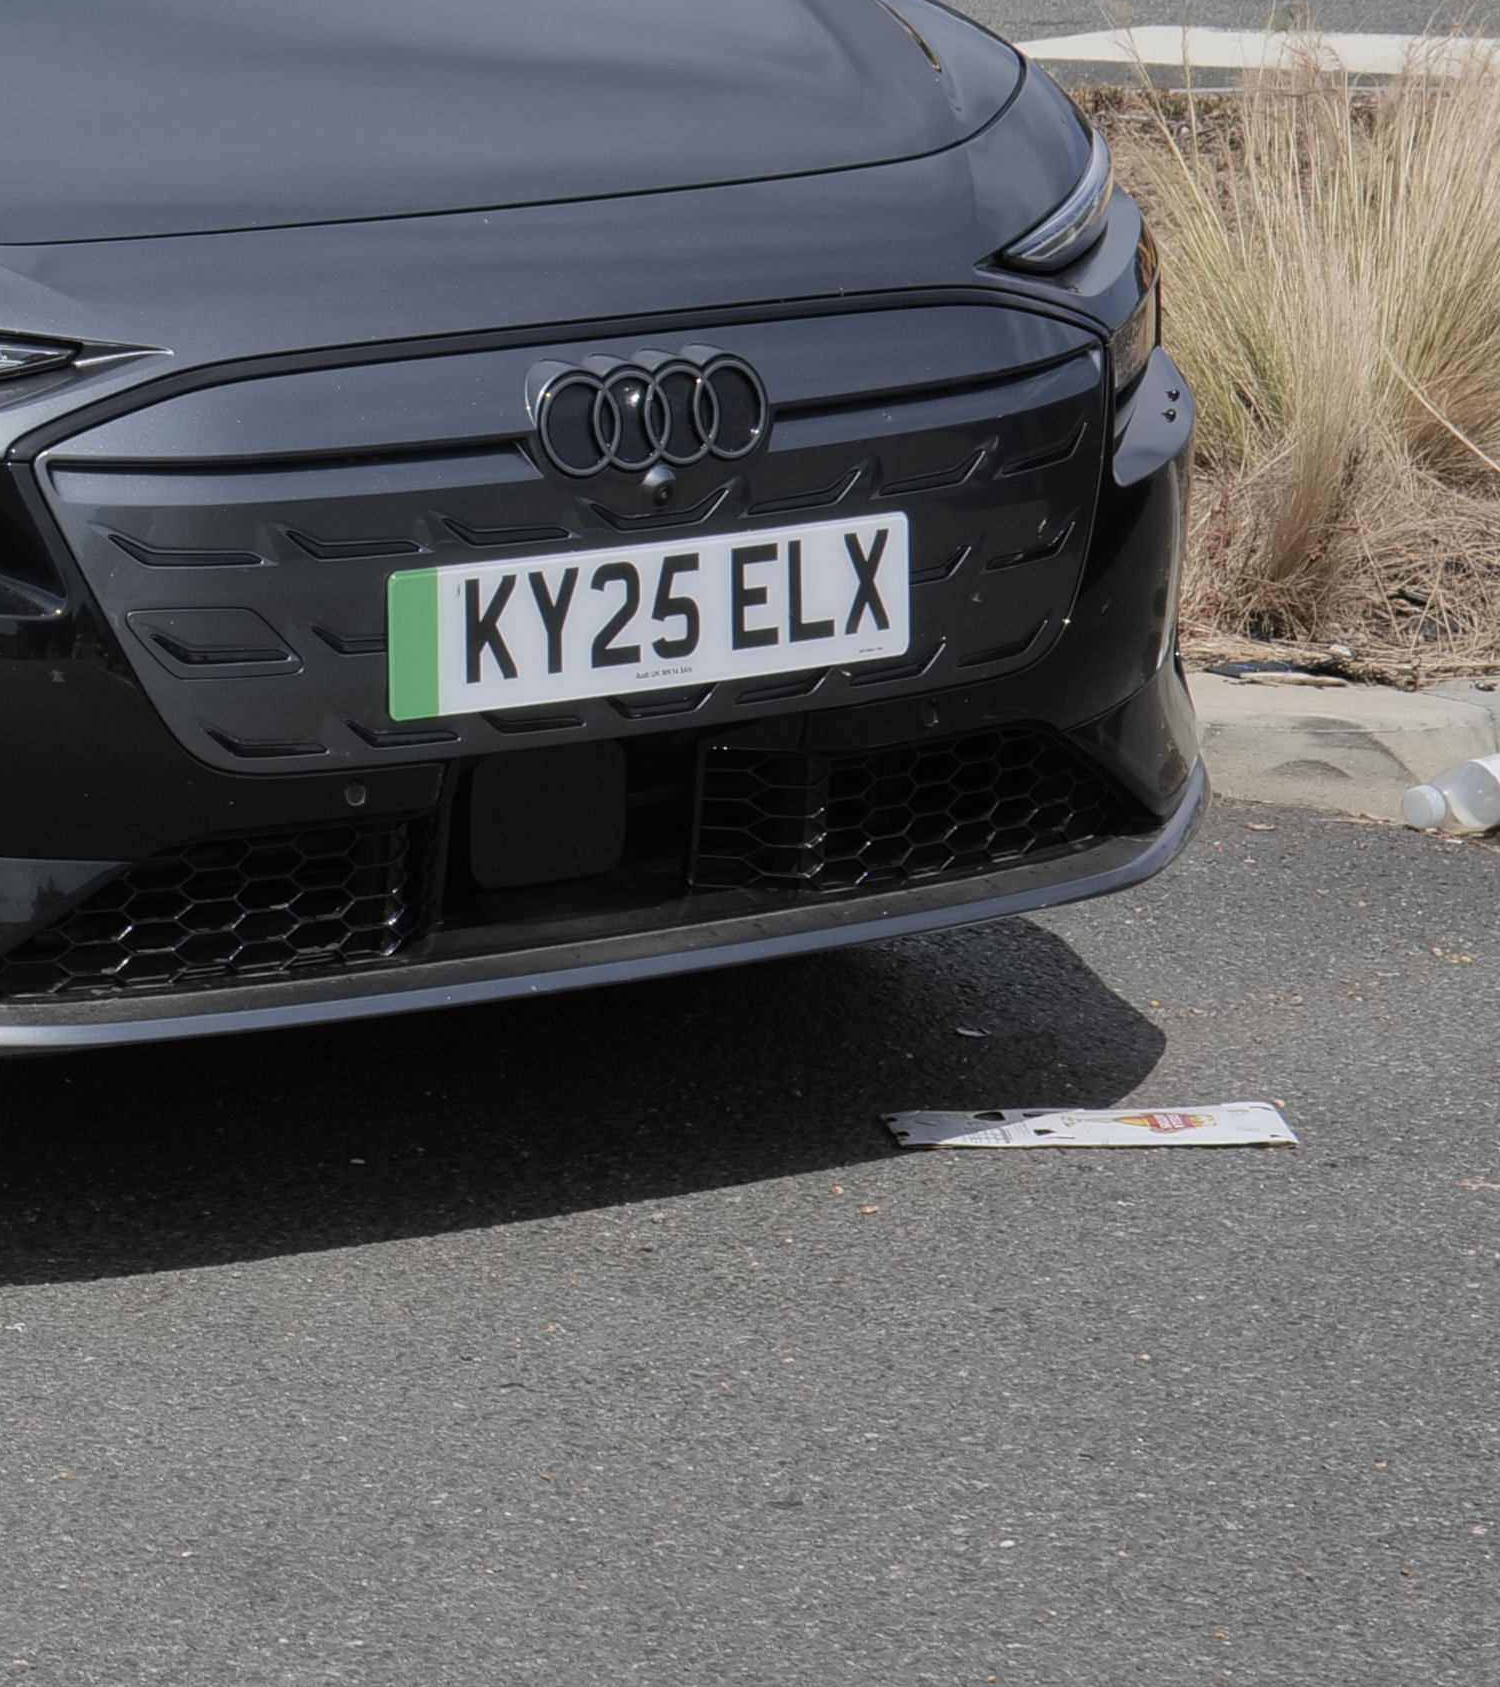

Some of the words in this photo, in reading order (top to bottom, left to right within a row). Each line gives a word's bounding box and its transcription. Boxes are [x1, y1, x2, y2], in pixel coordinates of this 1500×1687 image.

[464, 552, 700, 685] KY25
[731, 527, 891, 652] ELX
[651, 670, 661, 678] UK
